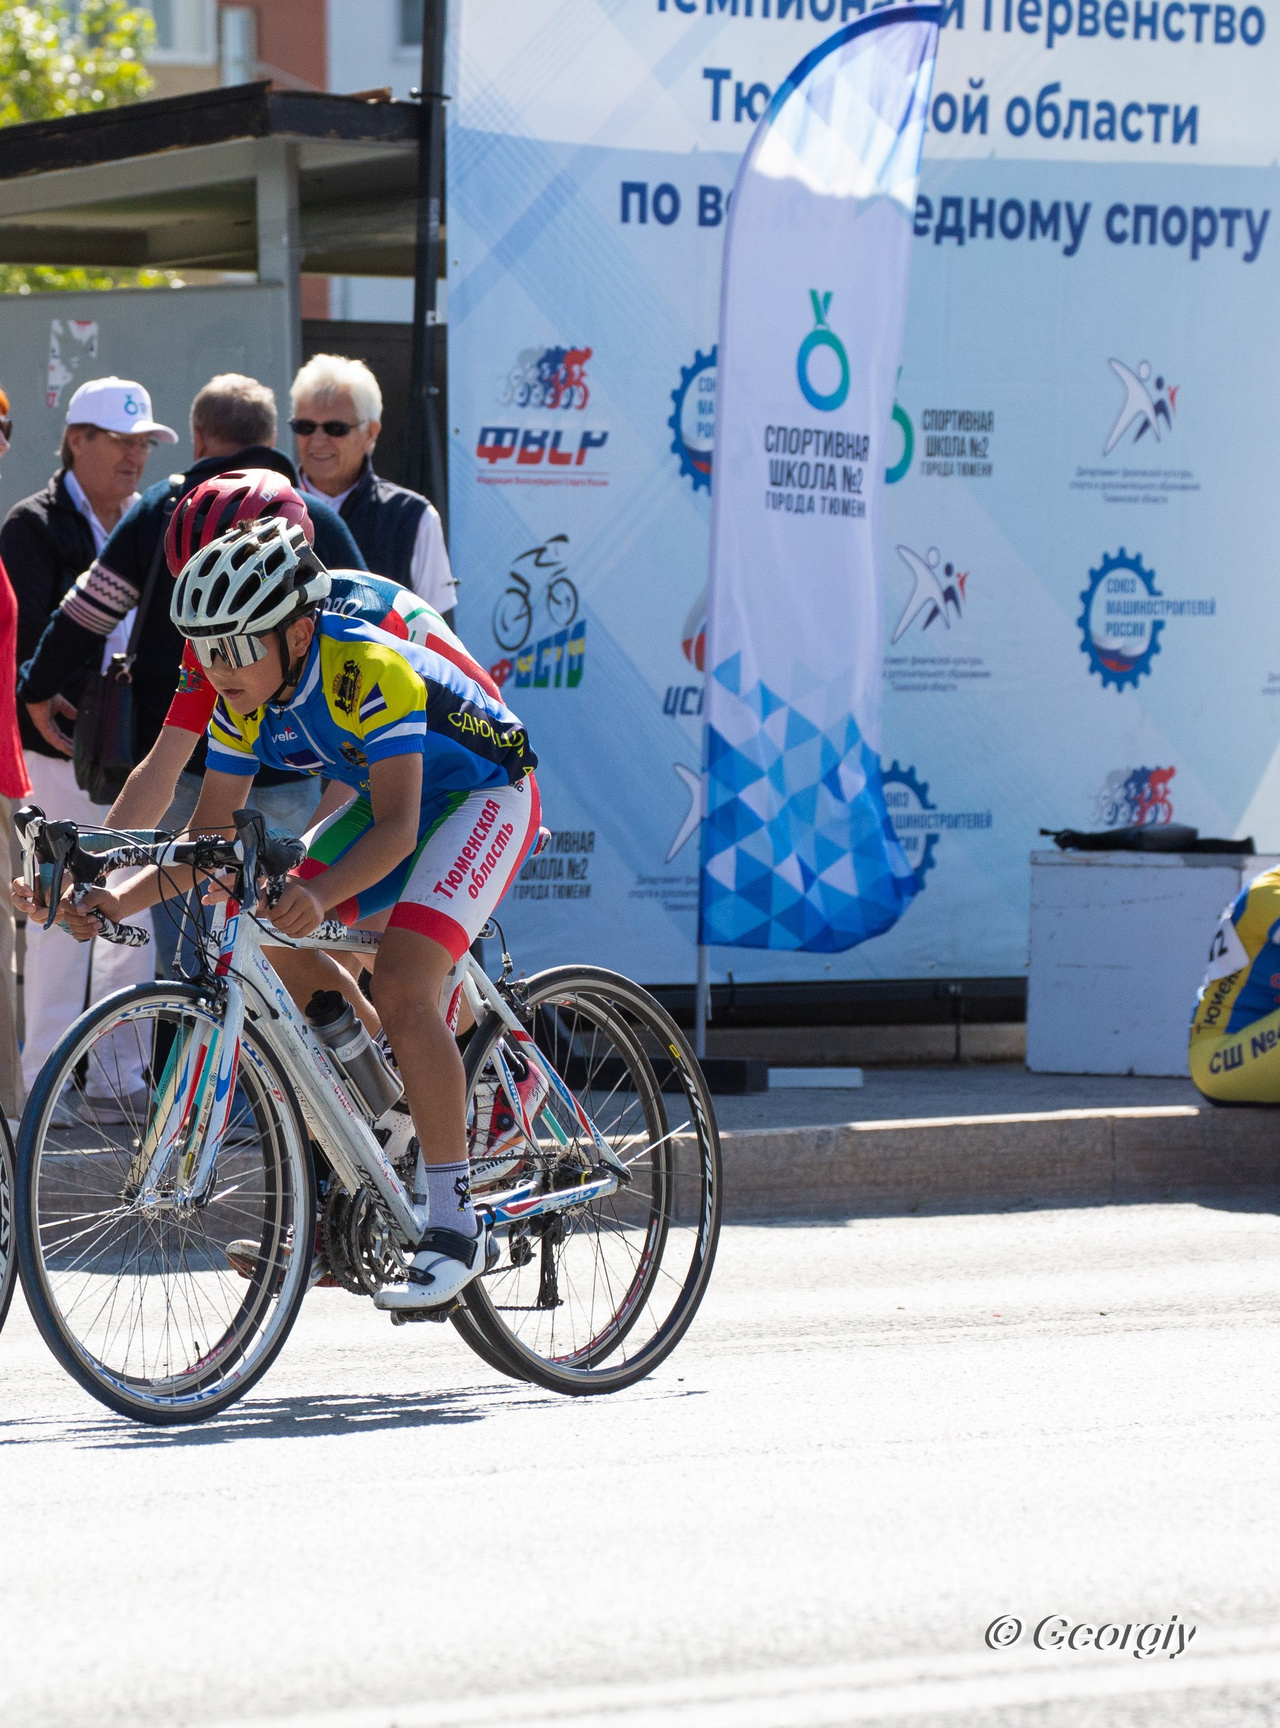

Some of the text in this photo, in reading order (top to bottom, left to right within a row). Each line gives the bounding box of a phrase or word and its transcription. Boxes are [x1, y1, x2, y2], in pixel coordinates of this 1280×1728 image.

[1006, 80, 1199, 145] области
[621, 181, 682, 226] по
[1105, 203, 1271, 264] спорту
[922, 409, 995, 433] СПОРТИВНАЯ
[765, 425, 869, 462] СПОРТИВНАЯ
[926, 435, 966, 457] ШКОЛА
[770, 459, 864, 494] ШКОЛА №2
[766, 490, 867, 518] ГОРОДА ТЮМЕН
[1106, 577, 1137, 593] СОЮЗ
[432, 798, 502, 899] Тюменская
[550, 831, 595, 854] ТИВНАЯ
[467, 821, 514, 900] область
[520, 857, 589, 881] ШКОЛА №2
[1209, 1042, 1245, 1076] СШ
